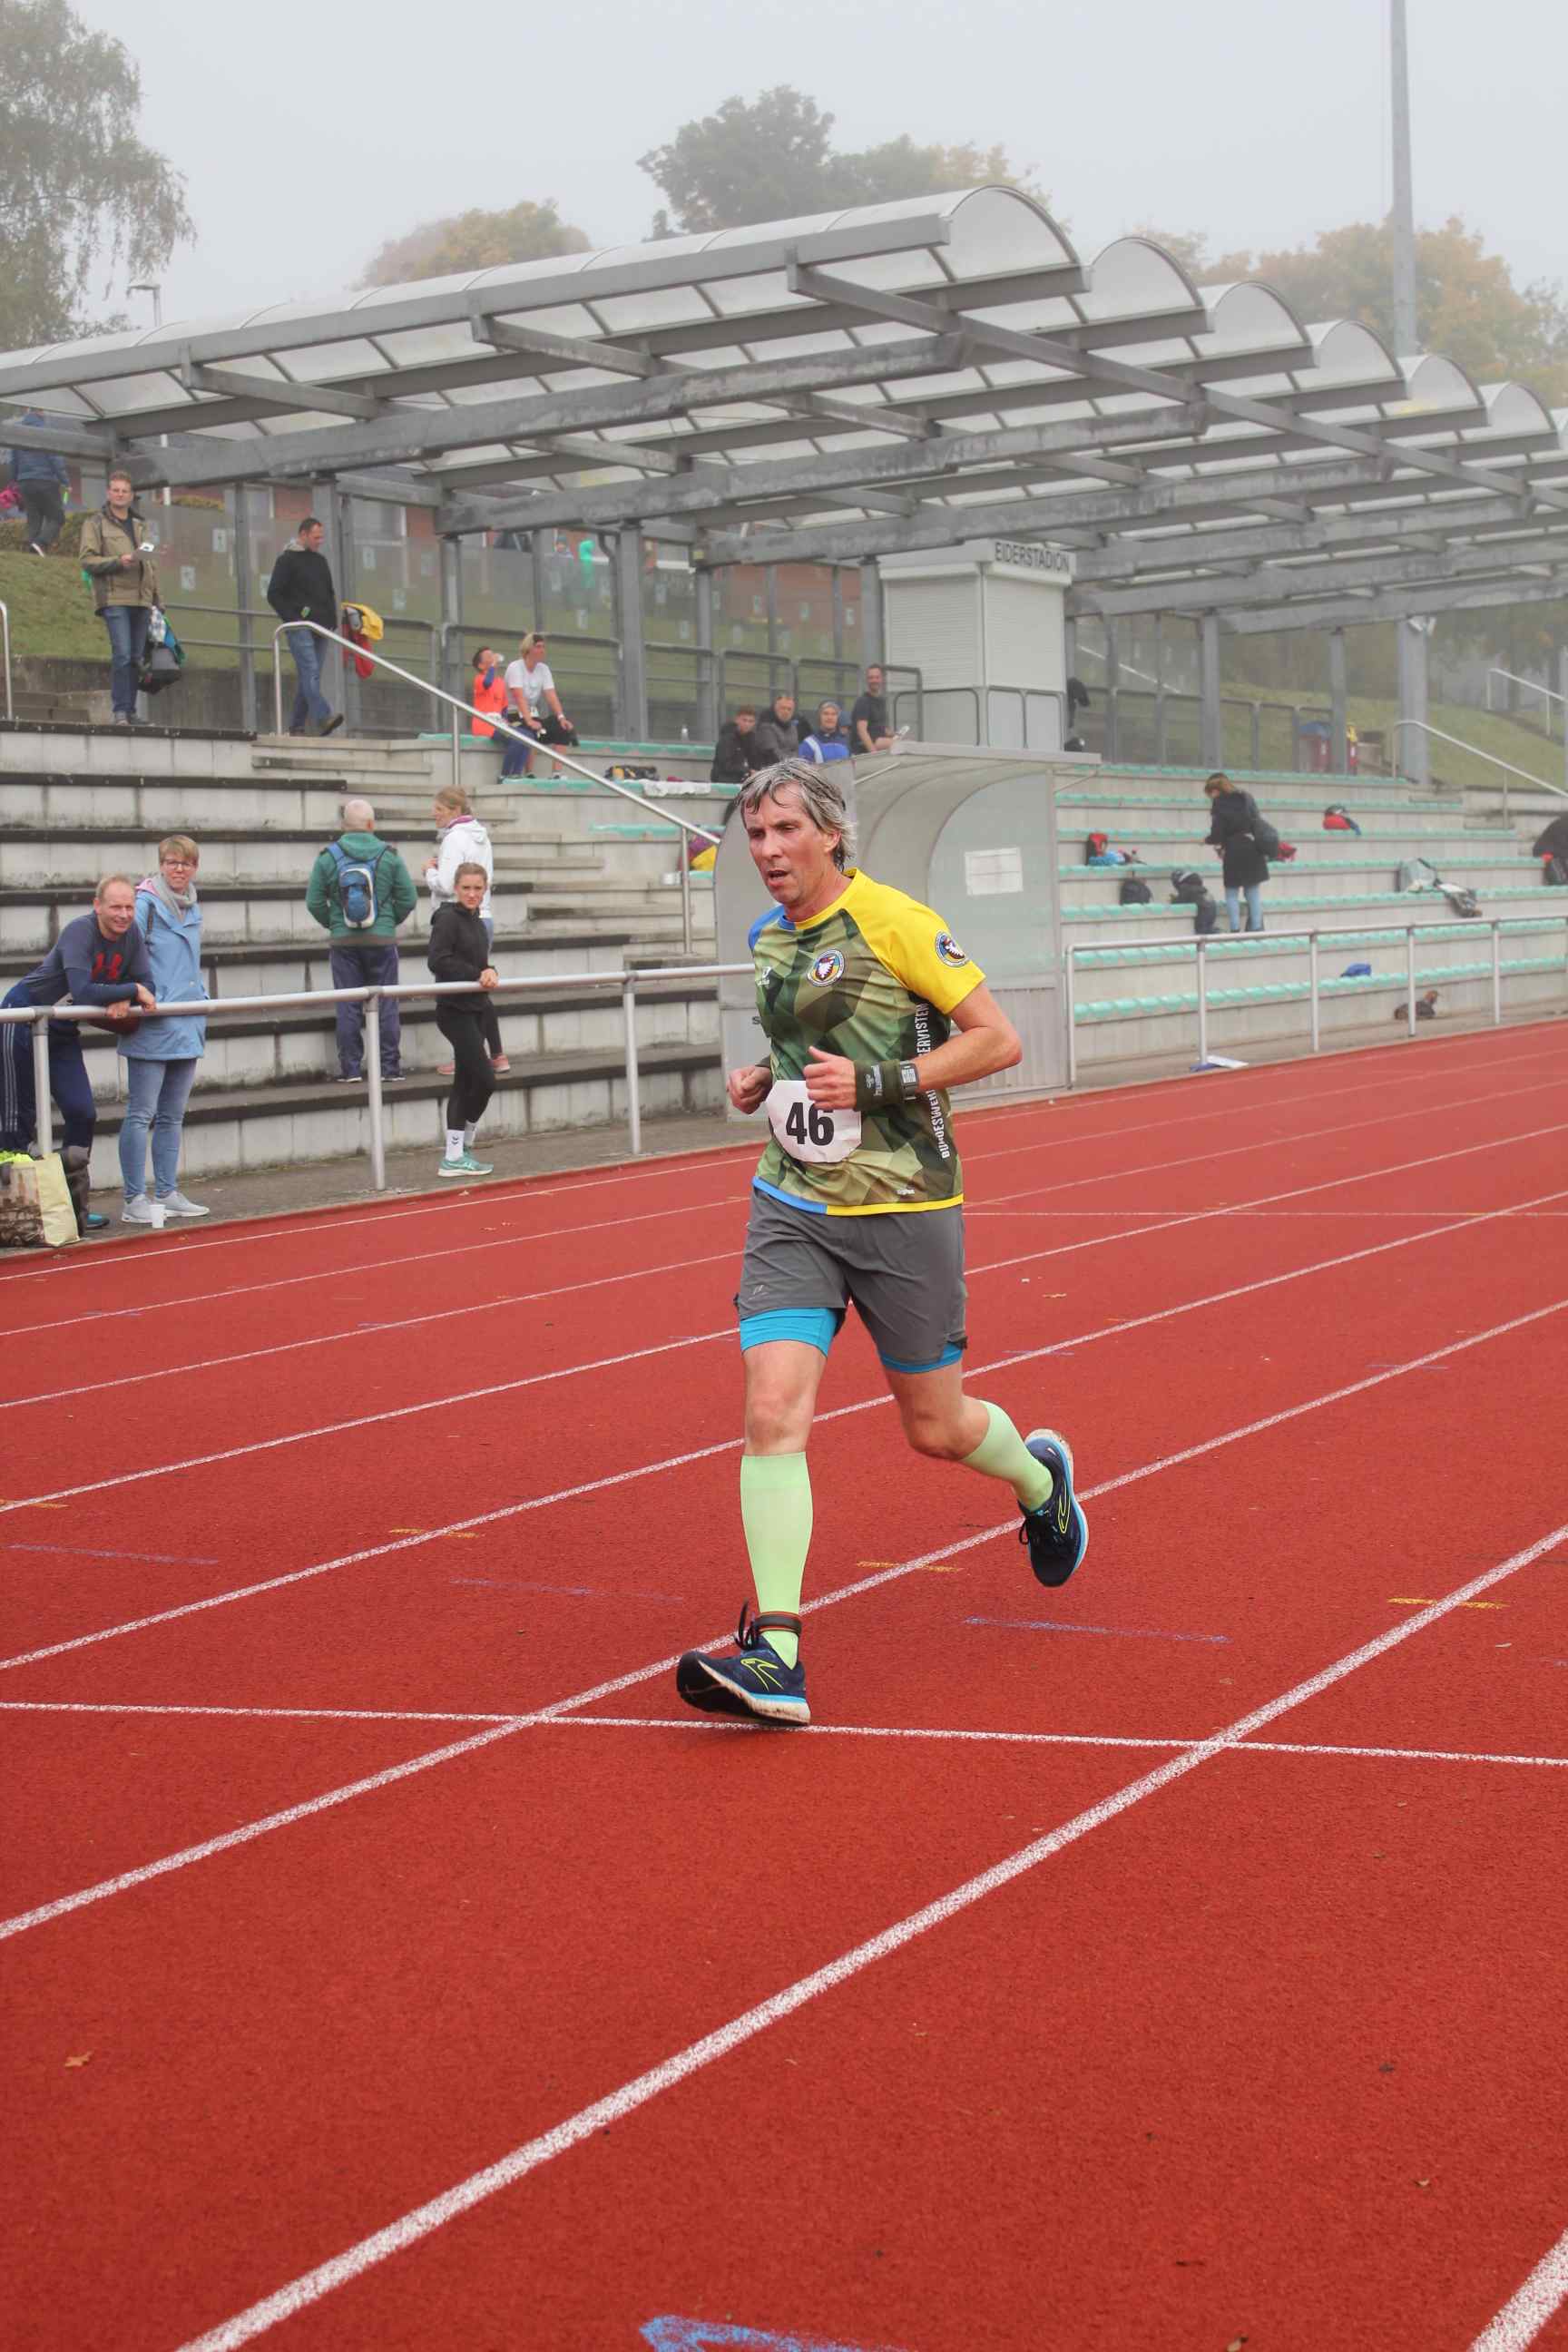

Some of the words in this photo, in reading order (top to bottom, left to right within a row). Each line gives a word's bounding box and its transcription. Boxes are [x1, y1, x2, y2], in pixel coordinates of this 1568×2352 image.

[995, 542, 1070, 574] EIDERSTADION
[915, 1002, 931, 1056] ERVISTEN
[786, 1102, 834, 1146] 46
